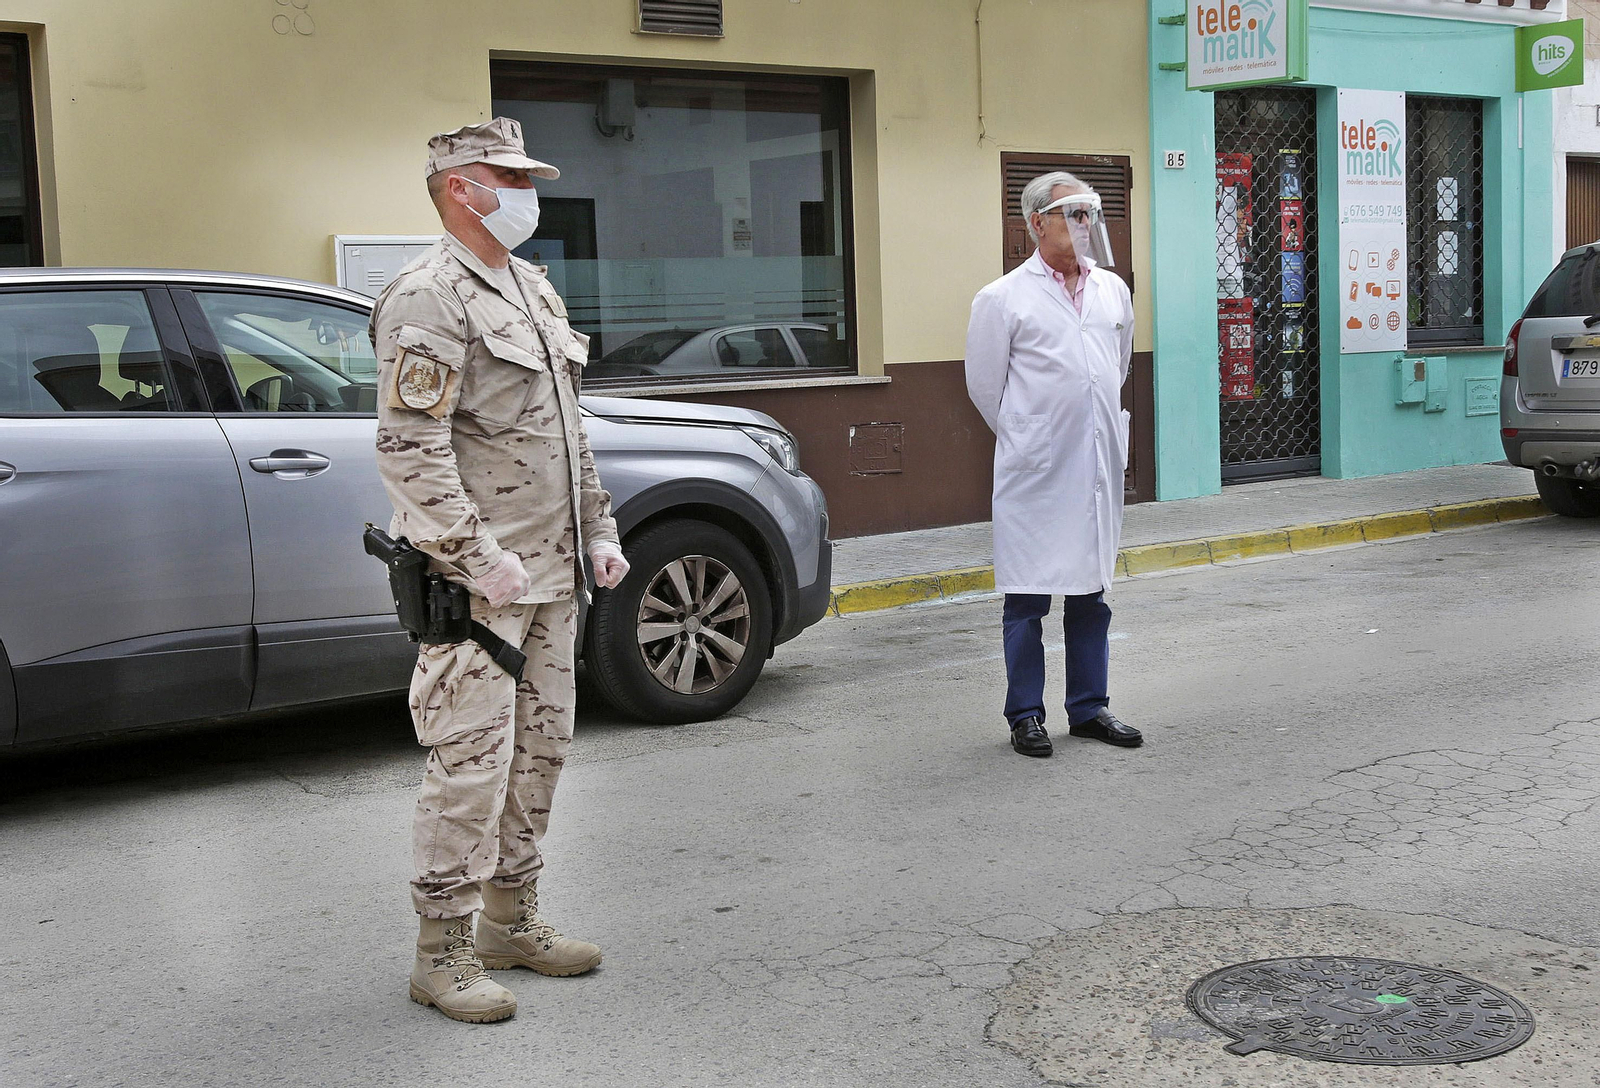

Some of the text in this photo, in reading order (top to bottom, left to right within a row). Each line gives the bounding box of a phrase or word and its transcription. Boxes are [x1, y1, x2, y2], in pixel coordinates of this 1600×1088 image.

[1197, 0, 1241, 36] tele
[1538, 43, 1565, 61] hits
[1202, 60, 1277, 75] móviles redes telemática
[1341, 119, 1376, 151] tele
[1167, 152, 1185, 167] 85
[1346, 178, 1364, 186] móviles
[1349, 204, 1403, 217] 676 549 749
